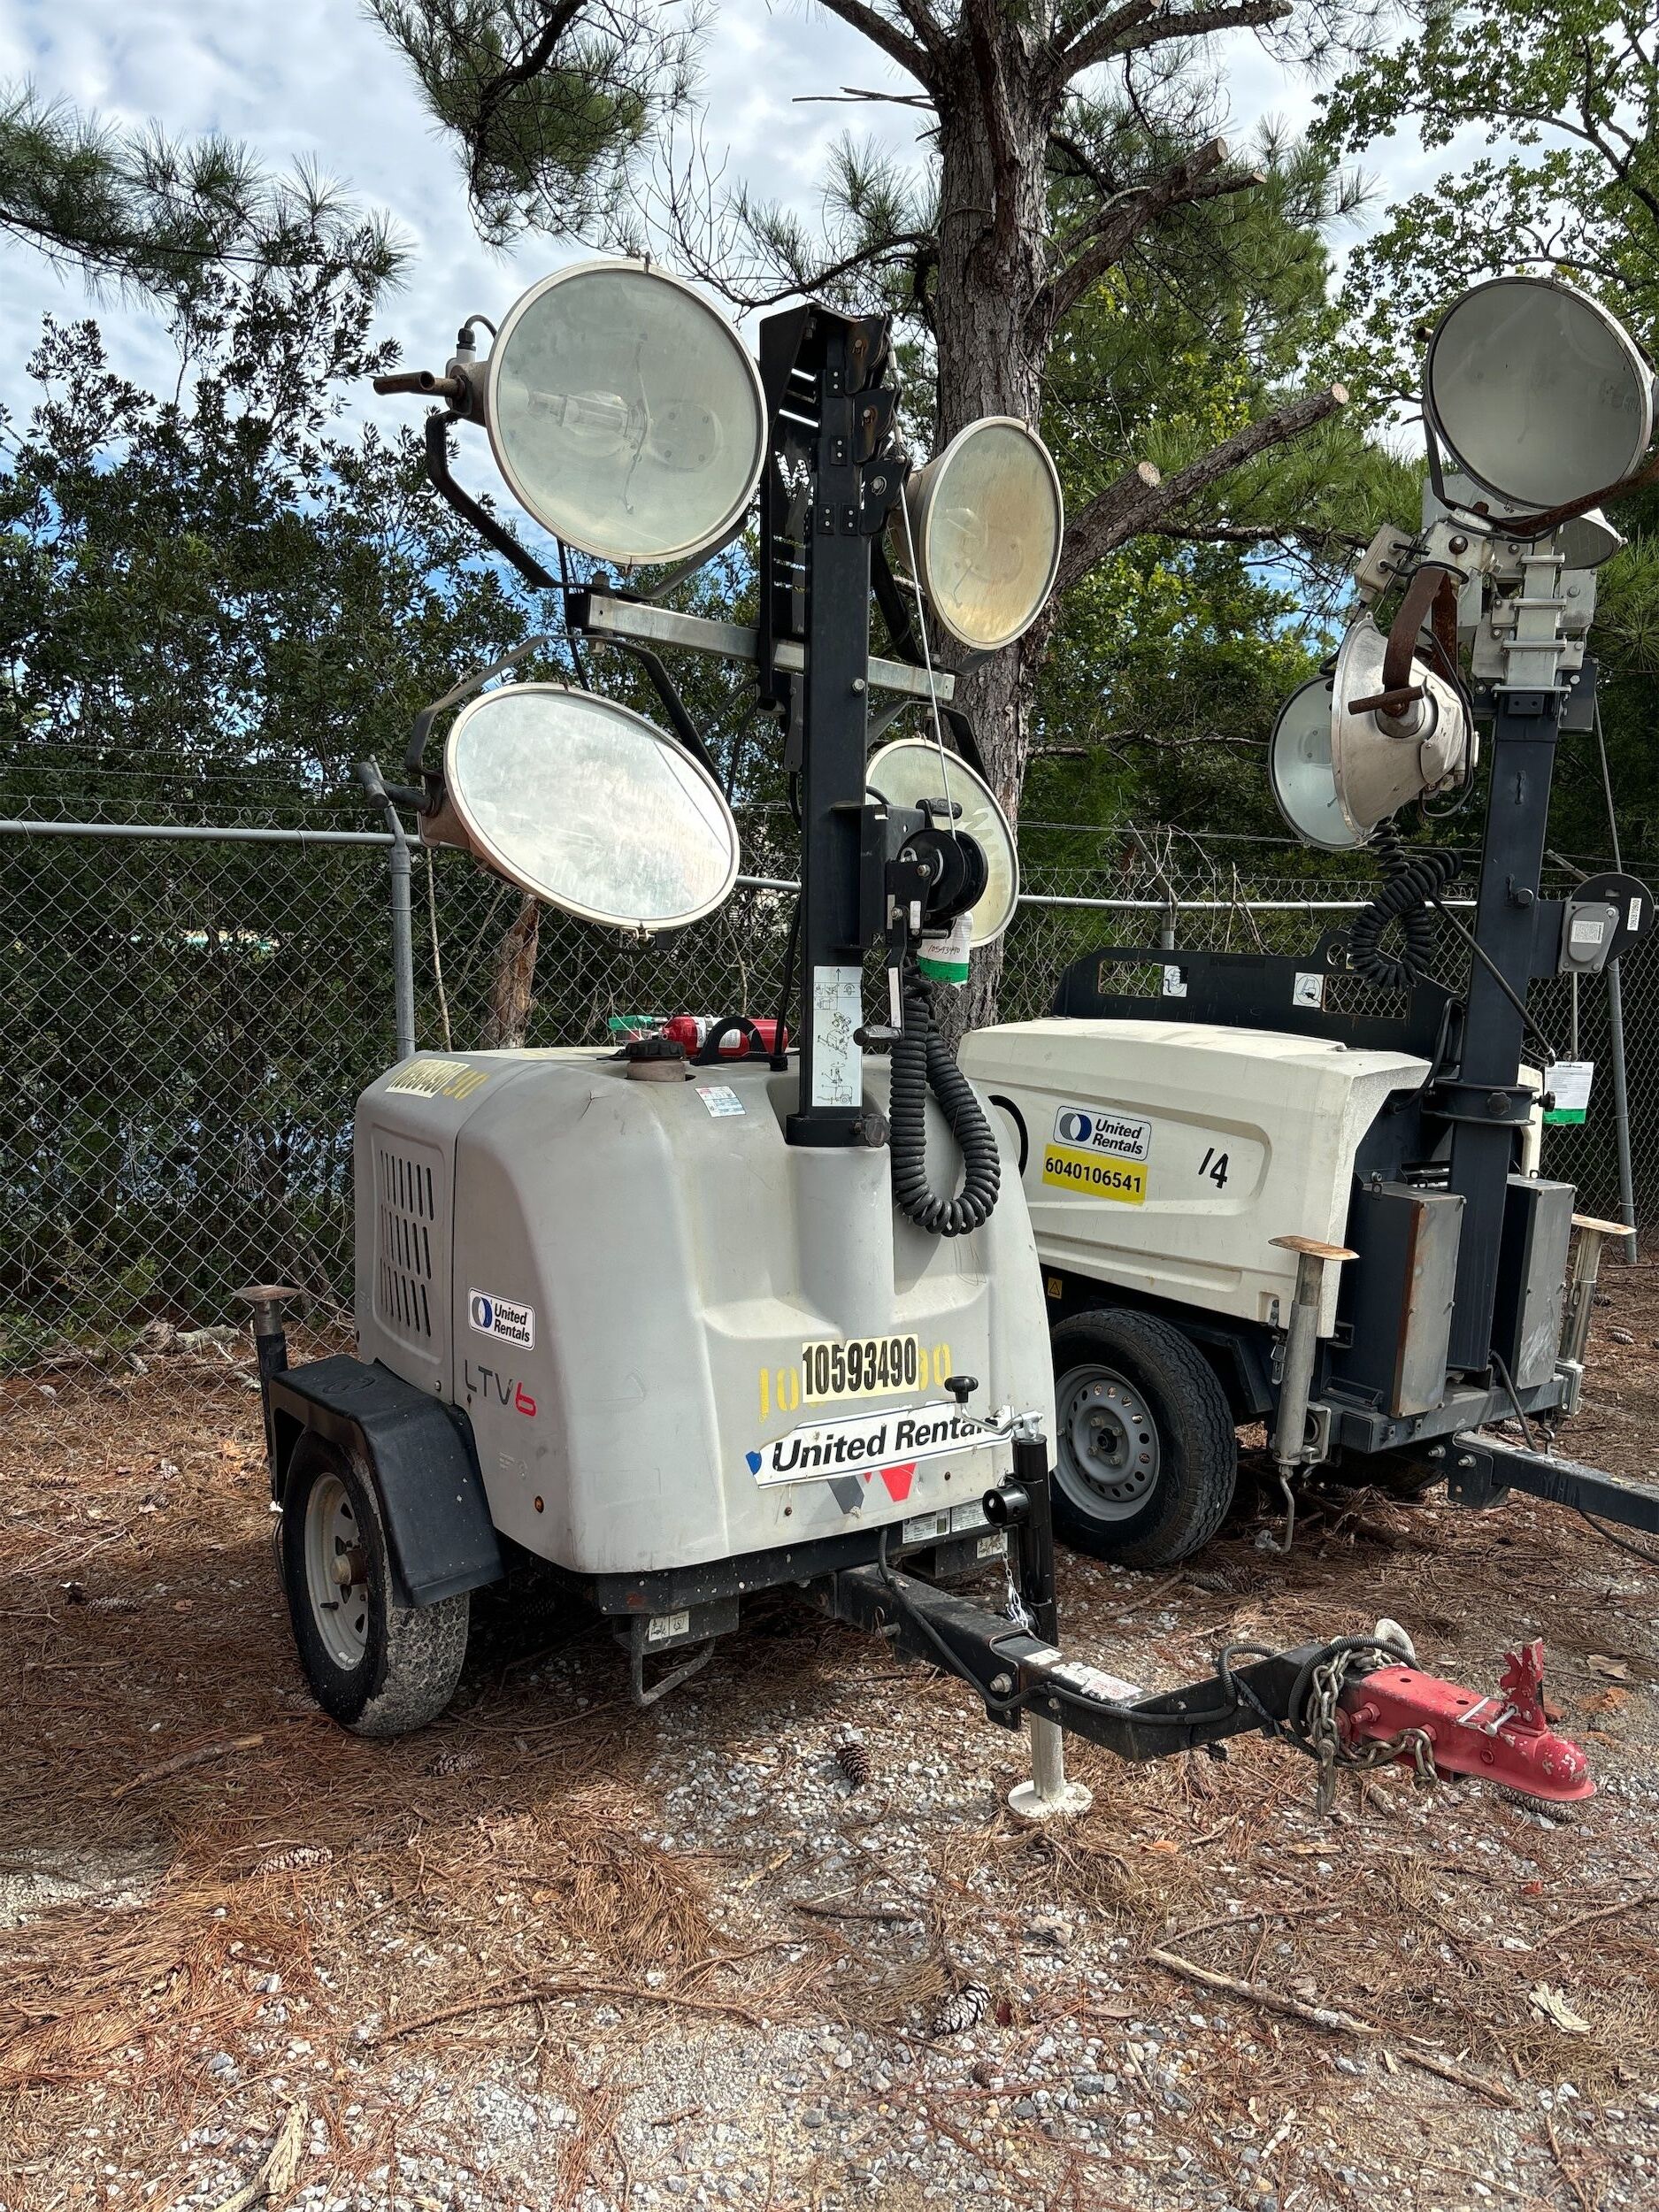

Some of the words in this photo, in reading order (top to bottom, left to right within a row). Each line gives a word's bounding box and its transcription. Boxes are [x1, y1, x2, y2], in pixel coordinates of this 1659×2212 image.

[1092, 1133, 1144, 1155] Rentals
[1094, 1118, 1143, 1140] United
[1045, 1156, 1141, 1193] 6040106541
[495, 1303, 527, 1325] United
[494, 1318, 530, 1342] Rentals
[802, 1337, 917, 1395] 10593490
[465, 1359, 537, 1417] LTV6
[772, 1425, 887, 1472] United
